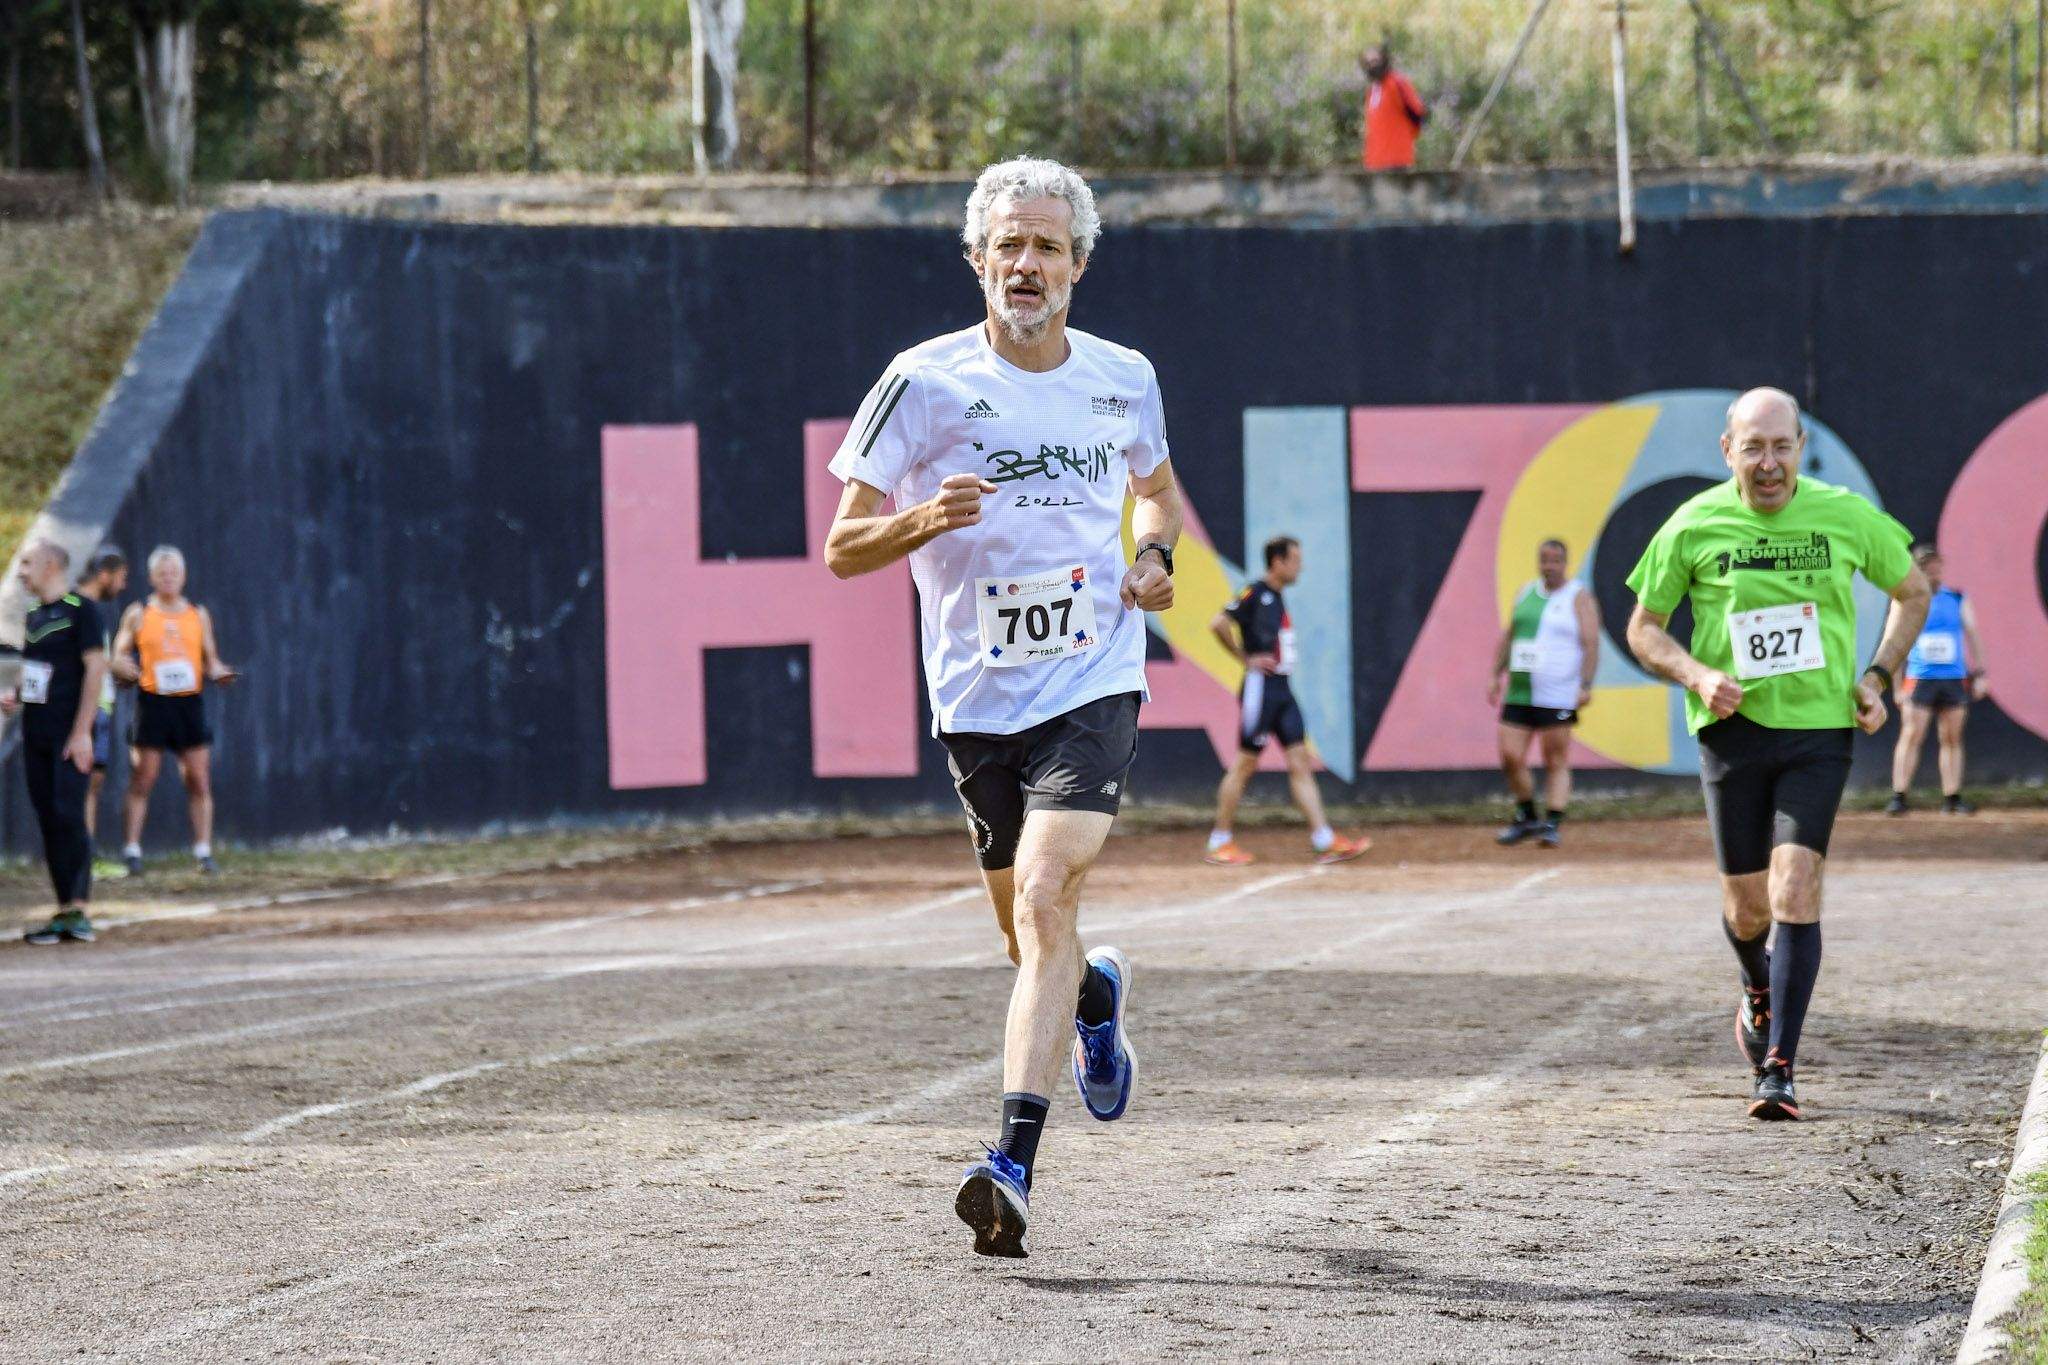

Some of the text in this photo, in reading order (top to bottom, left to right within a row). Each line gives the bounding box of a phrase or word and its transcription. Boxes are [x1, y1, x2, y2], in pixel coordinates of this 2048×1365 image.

[964, 408, 1000, 419] adidas
[1014, 495, 1084, 508] 2022
[1740, 546, 1828, 559] BOMBEROS
[1774, 556, 1828, 571] de MADRID
[998, 597, 1073, 645] 707
[1749, 627, 1803, 661] 827
[977, 817, 991, 832] NEW
